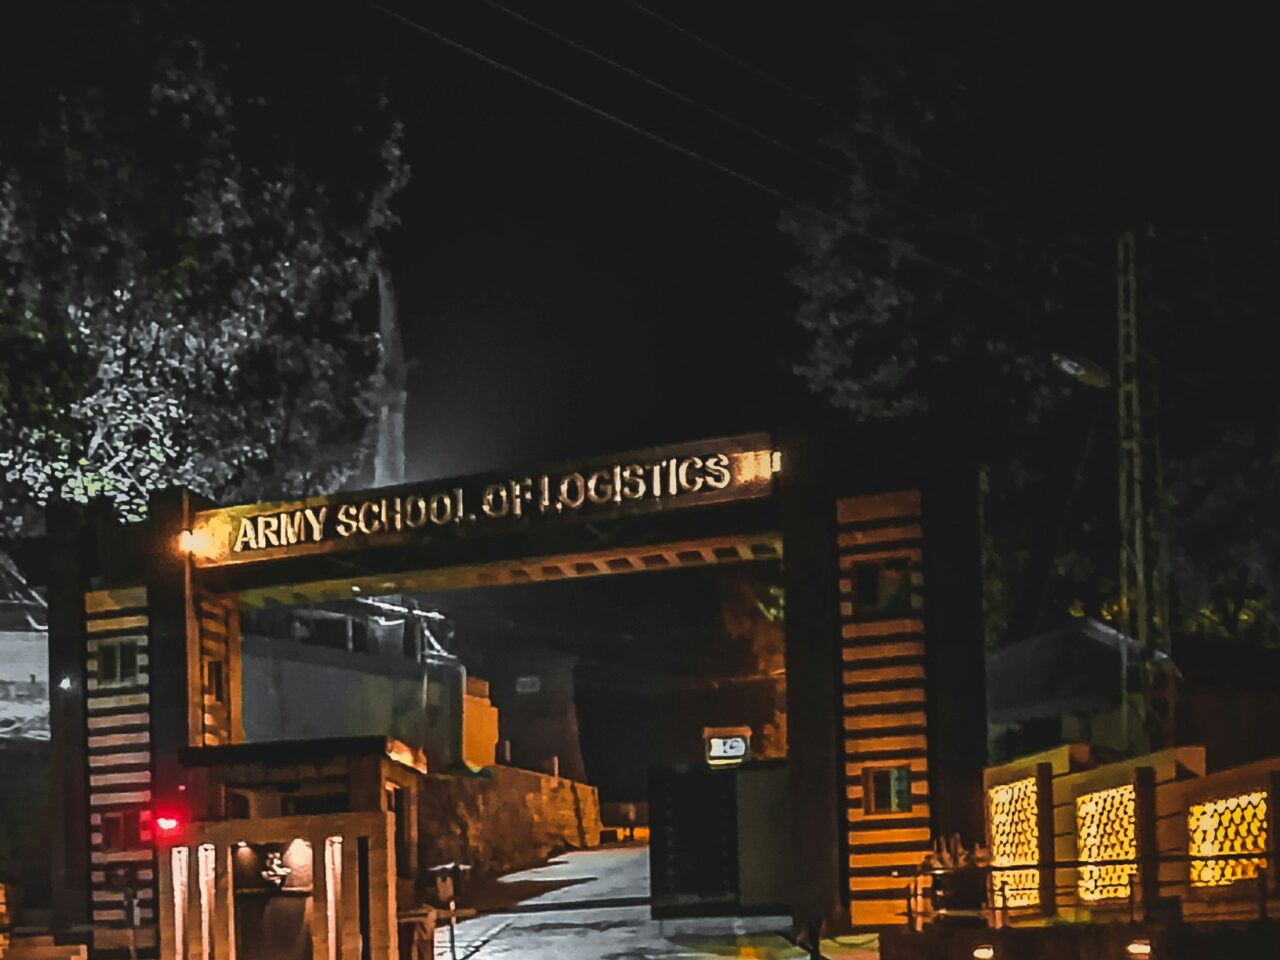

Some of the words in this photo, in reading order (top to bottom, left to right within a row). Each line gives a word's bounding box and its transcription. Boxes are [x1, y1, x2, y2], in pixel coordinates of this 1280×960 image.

[233, 506, 329, 552] ARMY
[336, 487, 477, 538] SCHOOL
[482, 476, 533, 519] OF
[538, 452, 731, 514] LOGISTICS
